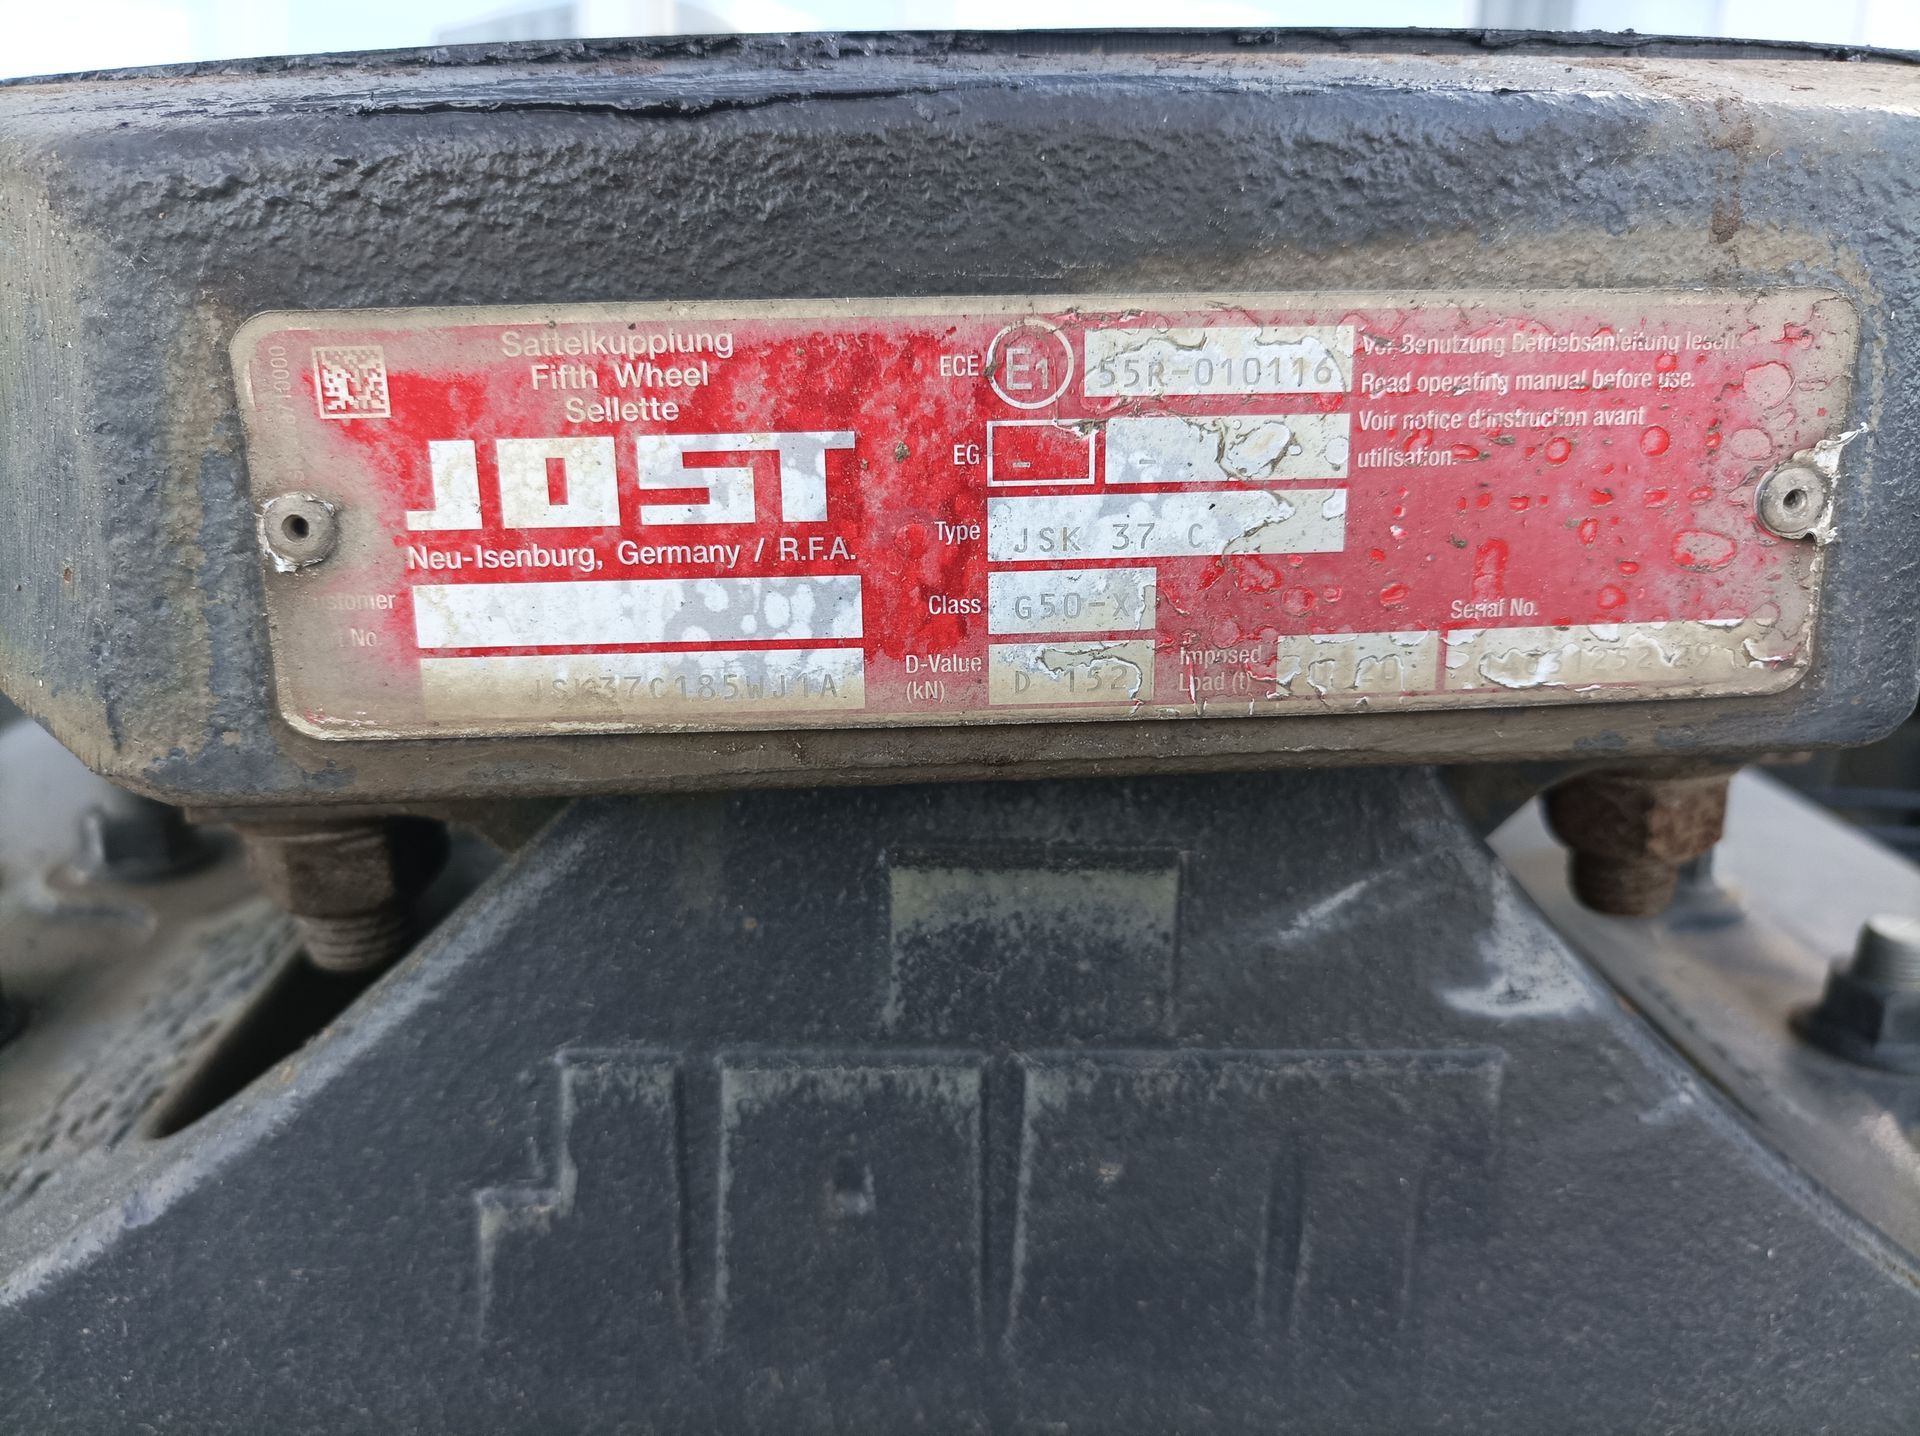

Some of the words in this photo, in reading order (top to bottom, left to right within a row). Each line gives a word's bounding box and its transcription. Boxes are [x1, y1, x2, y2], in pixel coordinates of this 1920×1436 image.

[502, 330, 734, 359] Sattelkupplung
[1399, 335, 1505, 357] Benutzung
[530, 363, 598, 391] Fifth
[614, 361, 710, 388] Wheel
[940, 356, 979, 376] ECE
[1005, 347, 1048, 390] E1
[1098, 357, 1333, 390] 55R-010116
[1361, 373, 1411, 394] Read
[1417, 371, 1508, 397] operating
[1515, 369, 1587, 392] manual
[1592, 368, 1652, 389] before
[1659, 371, 1696, 389] use.
[565, 397, 680, 424] Sellette
[1359, 410, 1397, 431] Voir
[1402, 409, 1462, 430] notice
[1593, 405, 1647, 427] avant
[953, 445, 980, 466] EG
[1357, 444, 1458, 468] utilisation.
[406, 431, 856, 531] JOST
[934, 521, 981, 545] Type
[1013, 525, 1082, 554] JSK
[1112, 522, 1157, 550] 37
[1187, 522, 1205, 549] C
[409, 543, 604, 573] Neu-Isenburg,
[617, 539, 741, 570] Germany
[753, 539, 764, 565] /
[779, 536, 857, 562] R.F.A.
[928, 593, 982, 615] Class
[1014, 591, 1130, 620] G50-X
[1451, 598, 1506, 620] Serial
[1510, 598, 1539, 618] No.
[905, 653, 982, 674] D-Value
[1179, 645, 1263, 667] Imposed
[905, 681, 946, 702] (kN)
[1014, 671, 1031, 694] D
[1065, 666, 1129, 693] 152
[1179, 672, 1224, 692] Load
